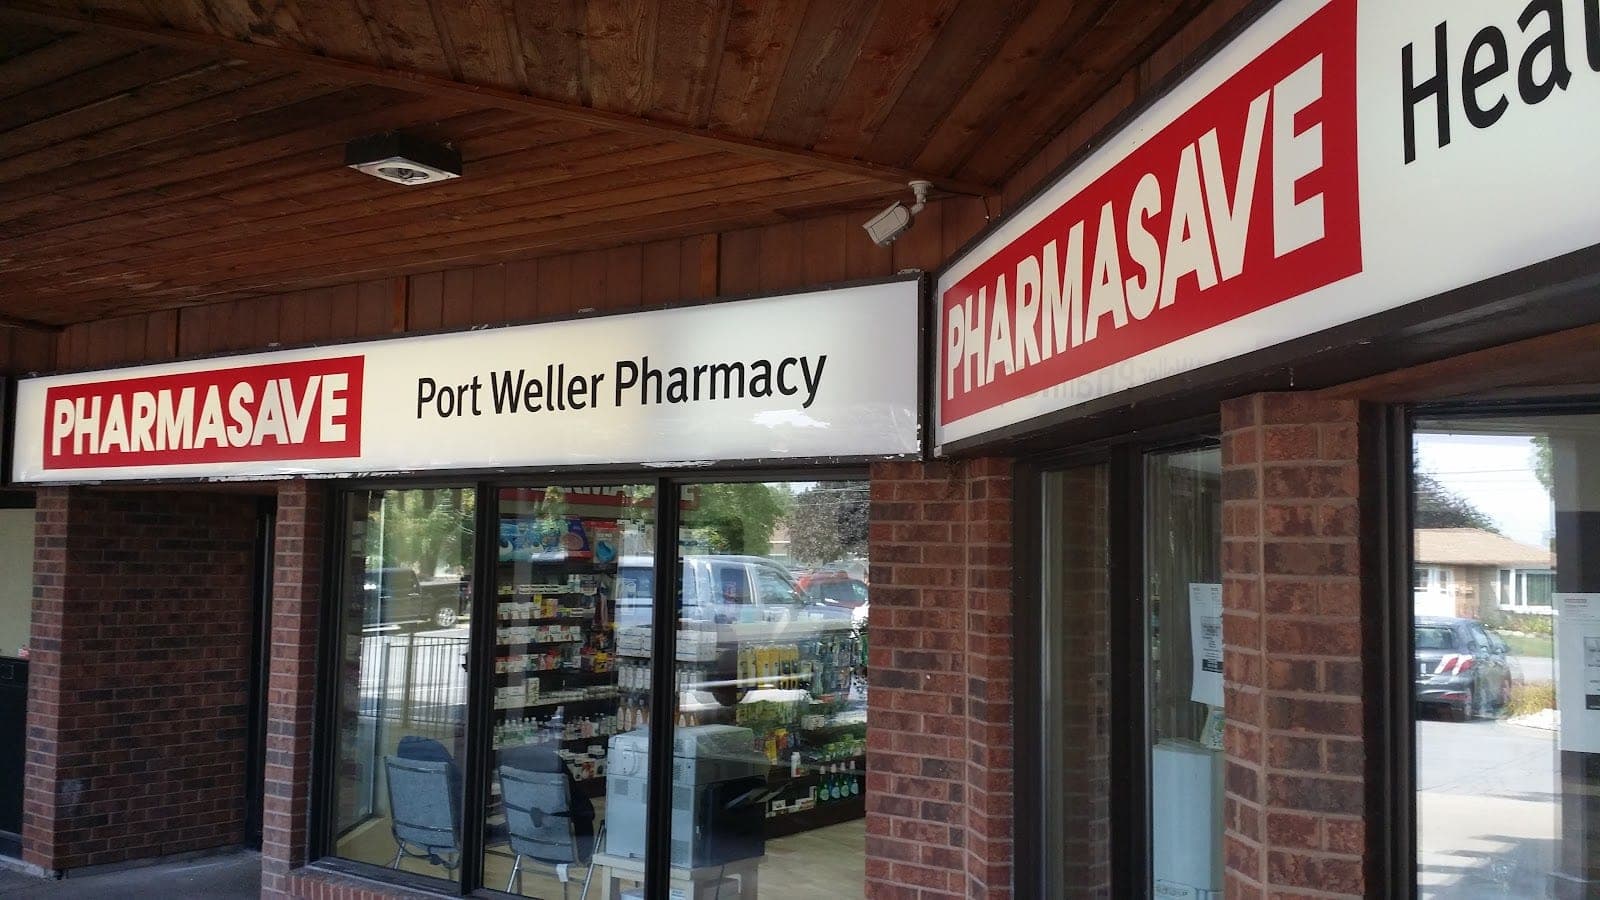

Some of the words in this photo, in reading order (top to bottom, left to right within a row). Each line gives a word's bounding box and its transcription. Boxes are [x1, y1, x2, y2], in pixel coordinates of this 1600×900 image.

[947, 53, 1325, 401] PHARMASAVE
[52, 373, 348, 457] PHARMASAVE
[417, 376, 482, 419] Port
[490, 363, 605, 415] Weller
[615, 354, 827, 409] Pharmacy
